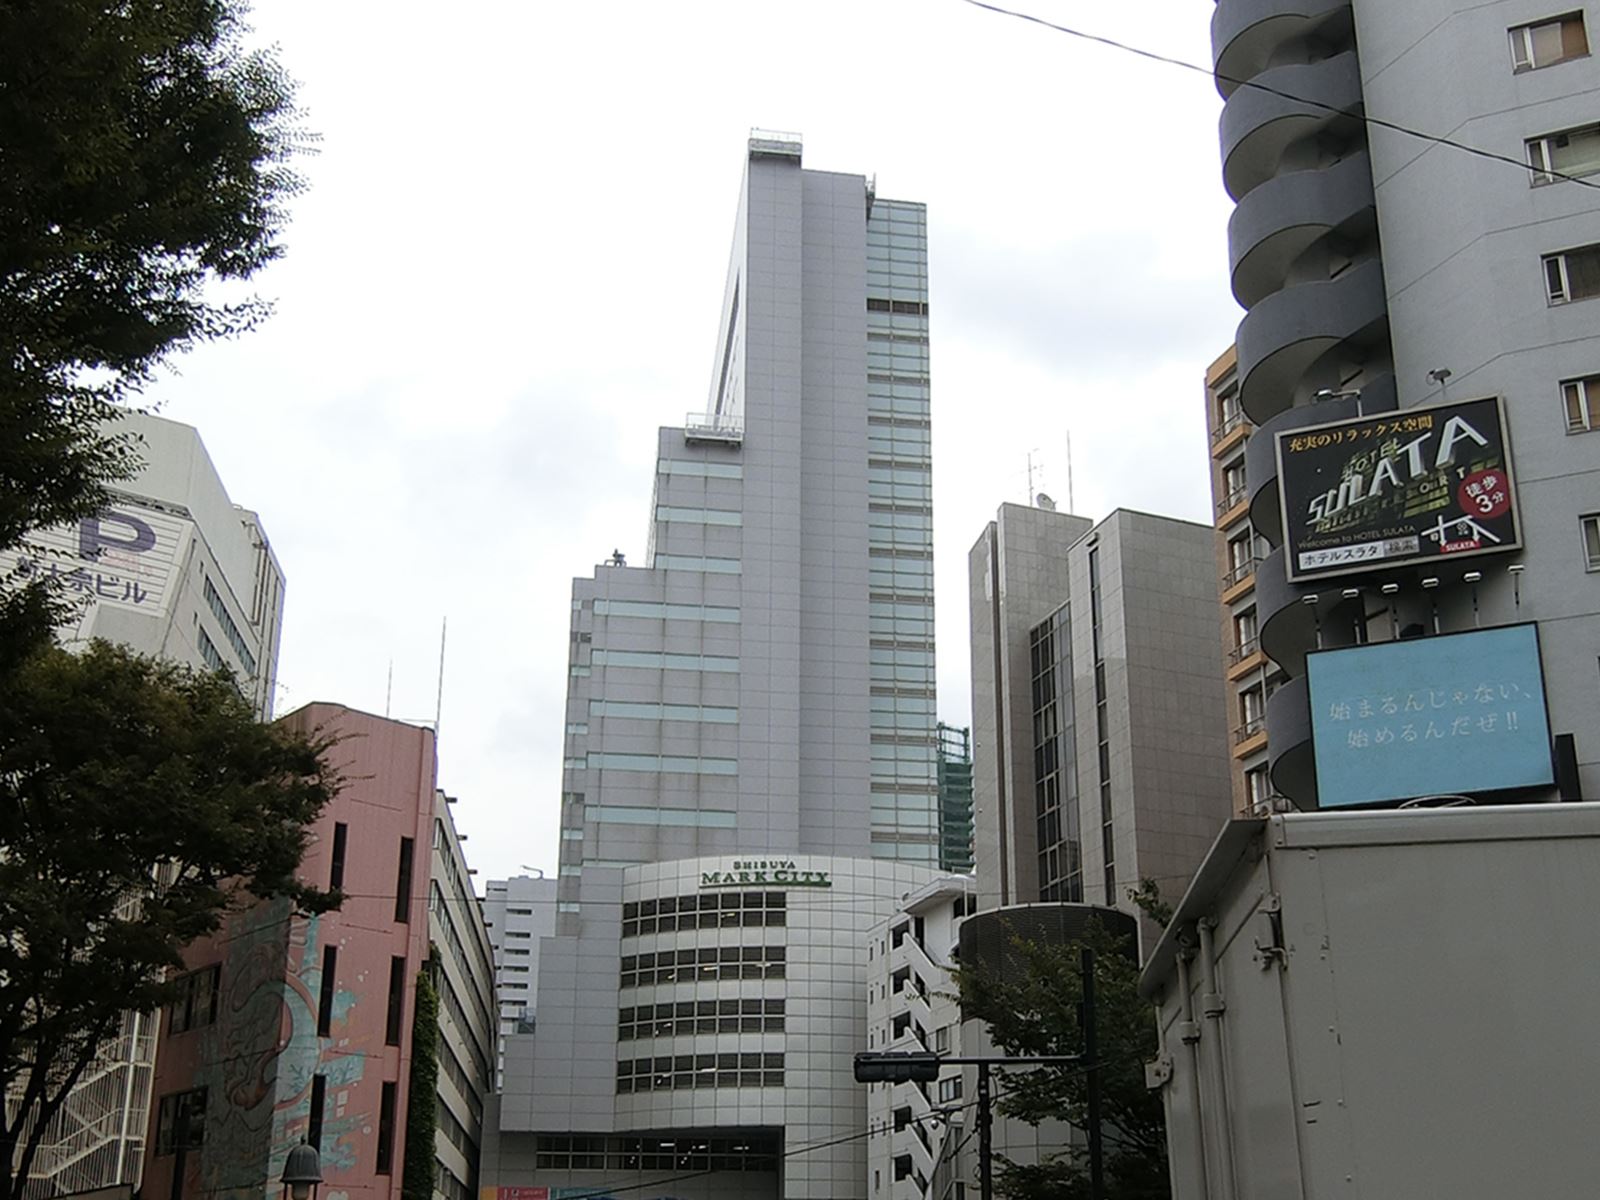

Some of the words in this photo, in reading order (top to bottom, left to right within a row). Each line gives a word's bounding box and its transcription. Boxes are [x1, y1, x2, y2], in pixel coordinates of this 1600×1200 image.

[1289, 415, 1433, 452] 充実のリラックス空間
[1305, 415, 1488, 526] SULATA
[1465, 475, 1498, 498] 徒歩
[79, 510, 157, 563] P
[1297, 537, 1340, 549] Welcome
[1342, 535, 1352, 543] to
[1353, 530, 1381, 541] HOTEL
[1383, 525, 1415, 536] SULATA
[1446, 540, 1475, 552] SULATA
[1304, 546, 1378, 566] ホテルスラタ
[1329, 682, 1532, 721] 始まるんじゃない、
[733, 860, 795, 870] SHIBUYA
[702, 871, 766, 884] MARK
[774, 870, 829, 882] CITY
